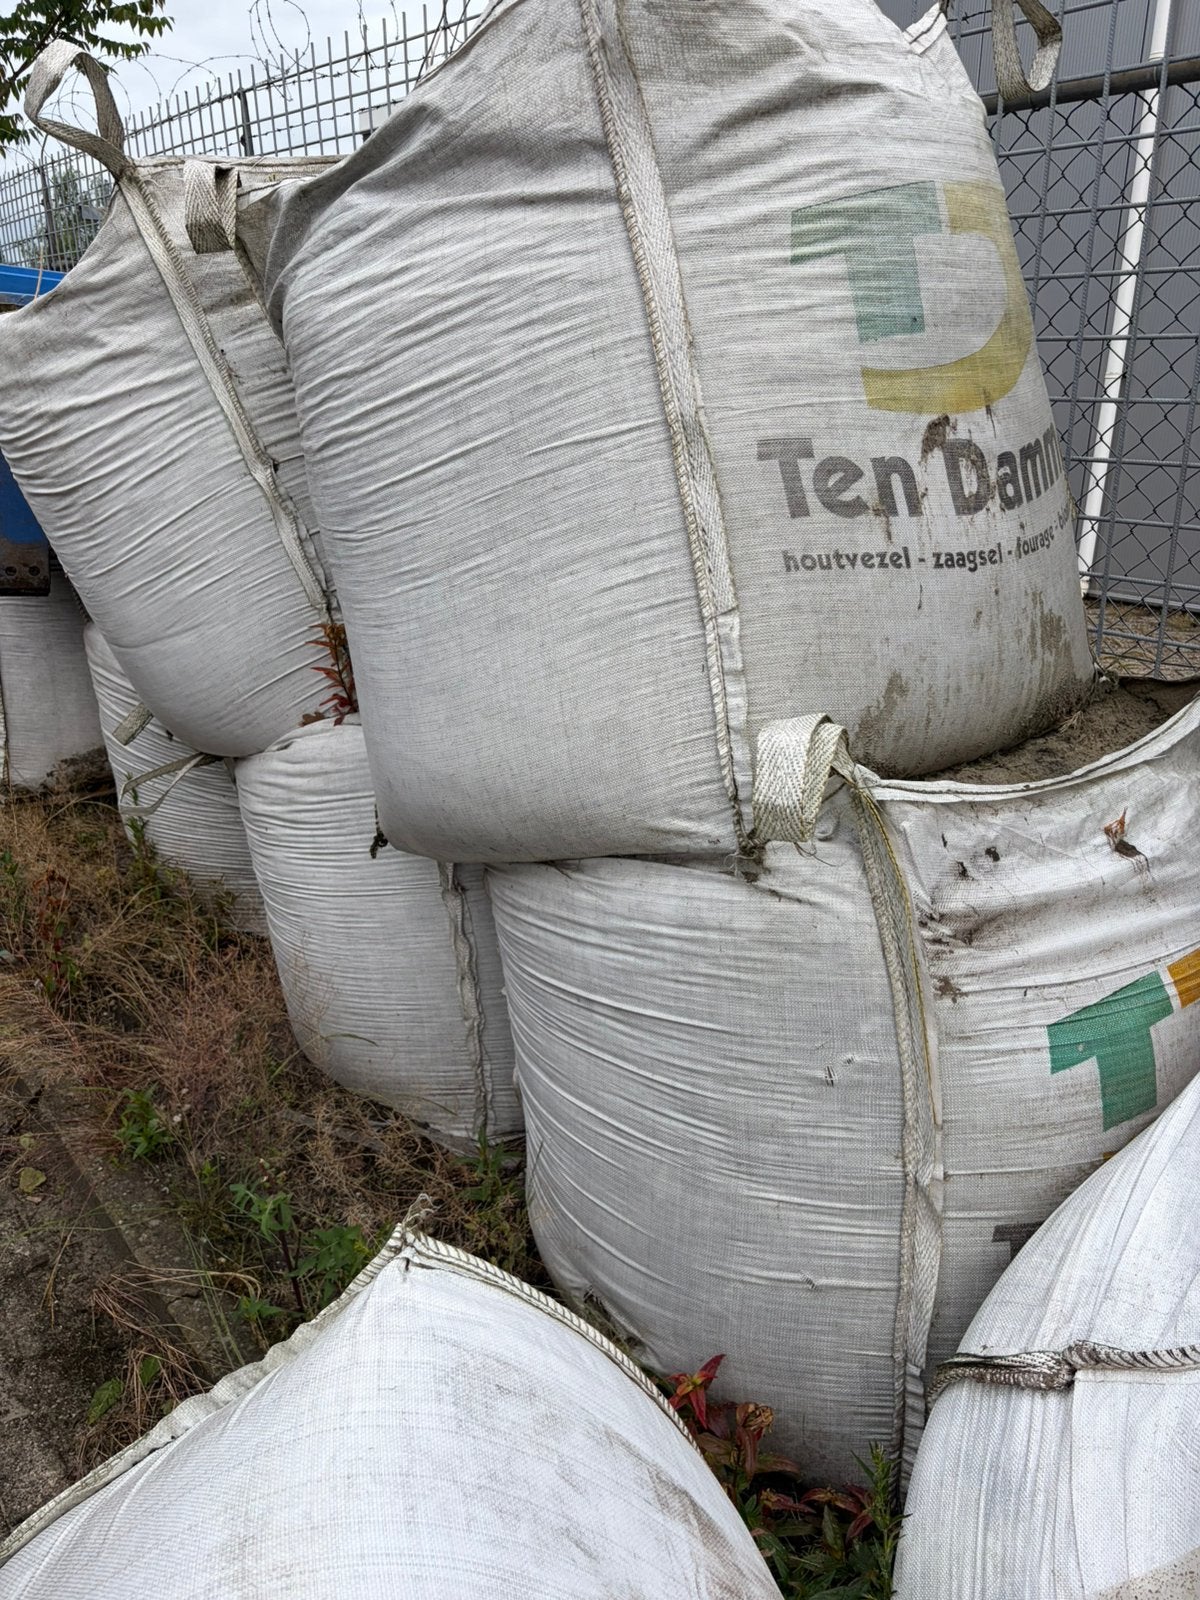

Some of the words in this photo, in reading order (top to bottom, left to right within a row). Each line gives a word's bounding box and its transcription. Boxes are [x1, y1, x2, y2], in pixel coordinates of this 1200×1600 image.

[757, 437, 923, 519] Ten
[784, 546, 911, 573] houtvezel
[933, 543, 1003, 573] zaagsel
[1015, 536, 1055, 560] fourage
